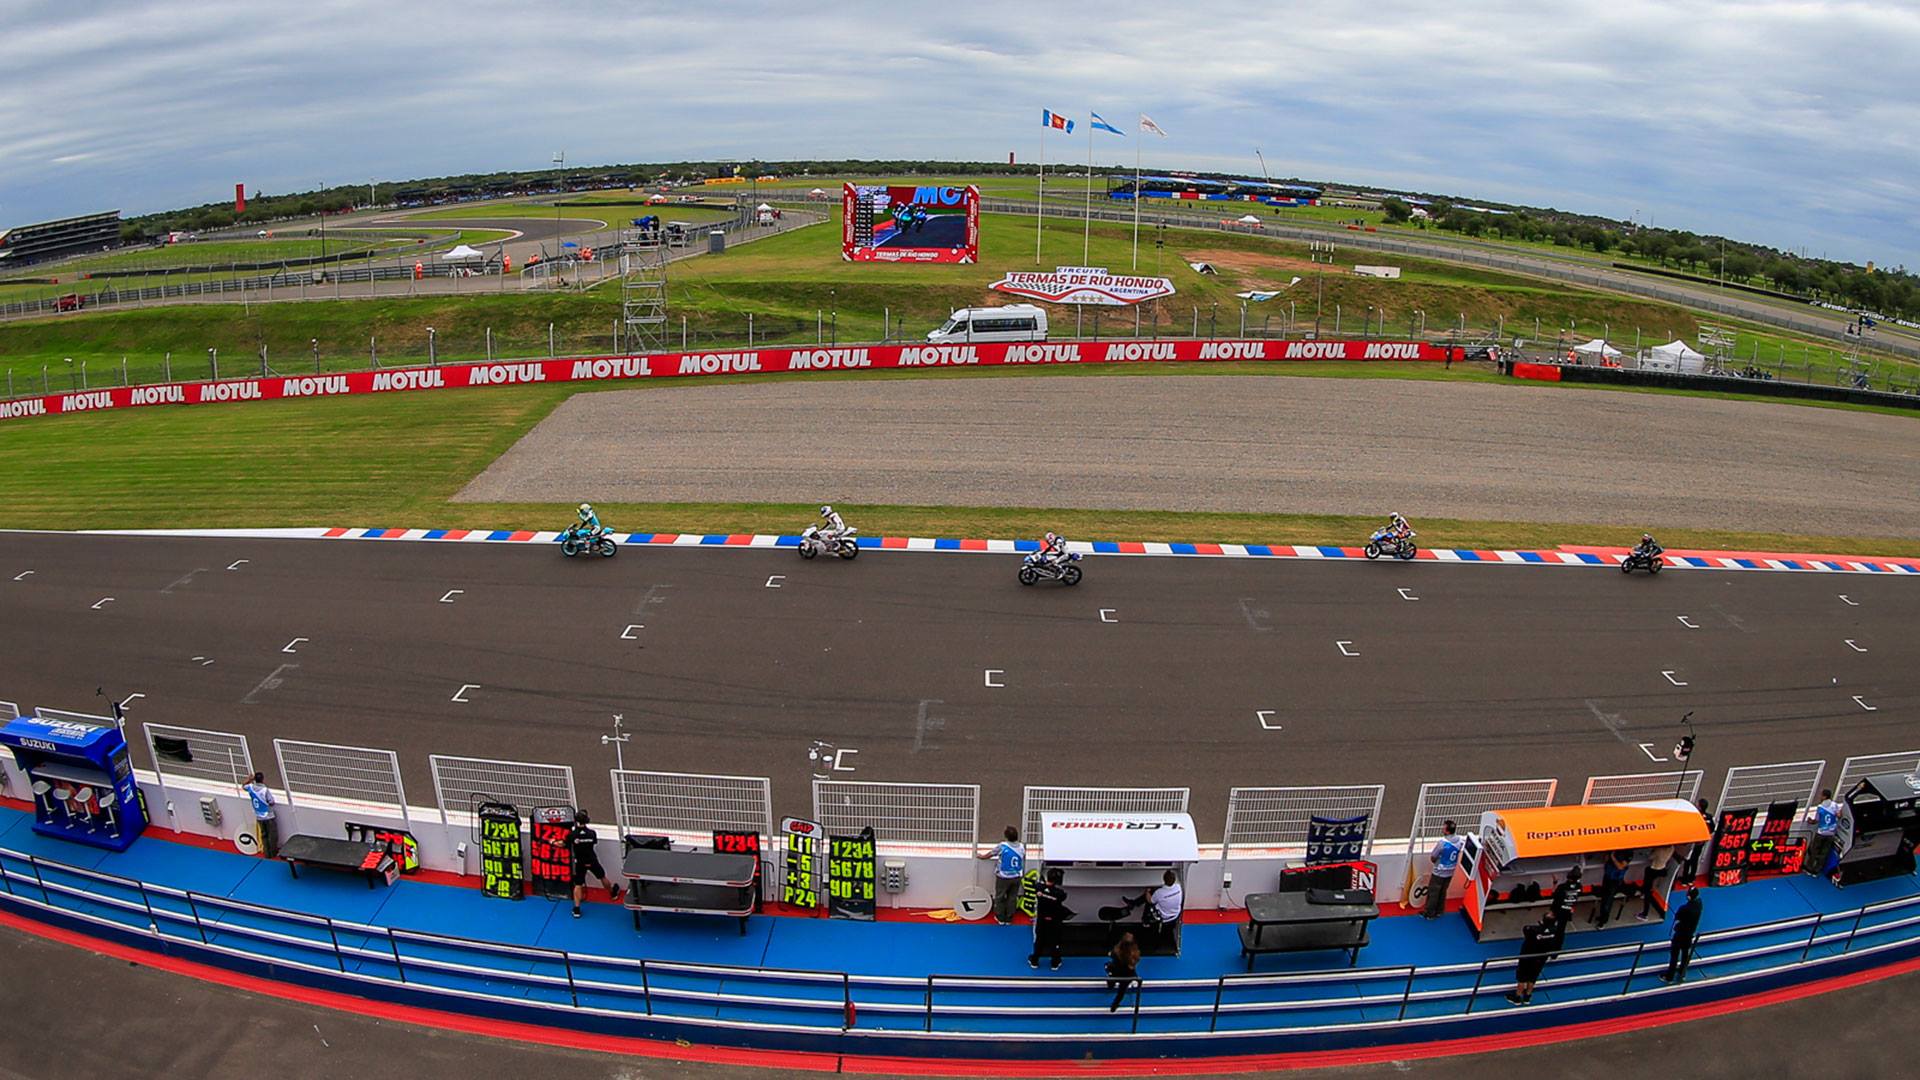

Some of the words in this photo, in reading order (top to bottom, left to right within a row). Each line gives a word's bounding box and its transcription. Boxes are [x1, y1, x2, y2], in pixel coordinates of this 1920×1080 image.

[1011, 273, 1067, 284] TERMAS
[1070, 275, 1087, 285] DE
[1089, 276, 1112, 286] RIO
[1115, 277, 1164, 289] HONDO
[1109, 287, 1149, 295] ARGENTINA
[788, 348, 872, 369] MOTUL
[898, 345, 980, 366] MOTUL
[1004, 344, 1082, 363] MOTUL
[1104, 343, 1177, 361] MOTUL
[1199, 342, 1265, 359] MOTUL
[1285, 342, 1346, 359] MOTUL
[1364, 343, 1420, 359] MOTUL
[571, 357, 651, 379] MOTUL
[678, 352, 761, 374] MOTUL
[372, 369, 444, 391] MOTUL
[468, 363, 546, 385] MOTUL
[200, 381, 261, 401] MOTUL
[282, 375, 349, 396] MOTUL
[62, 391, 113, 412] MOTUL
[131, 385, 185, 405] MOTUL
[0, 399, 46, 419] MOTUL
[28, 717, 100, 732] SUZUKI
[20, 737, 56, 751] SUZUKI
[253, 798, 260, 809] G
[1051, 821, 1124, 830] Honda
[1125, 821, 1179, 830] LCR
[1824, 814, 1831, 824] G
[1526, 829, 1575, 841] Repsol
[1578, 824, 1621, 836] Honda
[1622, 822, 1656, 833] Team
[715, 834, 758, 852] 1234
[832, 840, 874, 859] 1234
[1719, 833, 1749, 849] 4567
[1011, 856, 1019, 867] G
[1449, 850, 1457, 861] G
[830, 859, 874, 879] 5678
